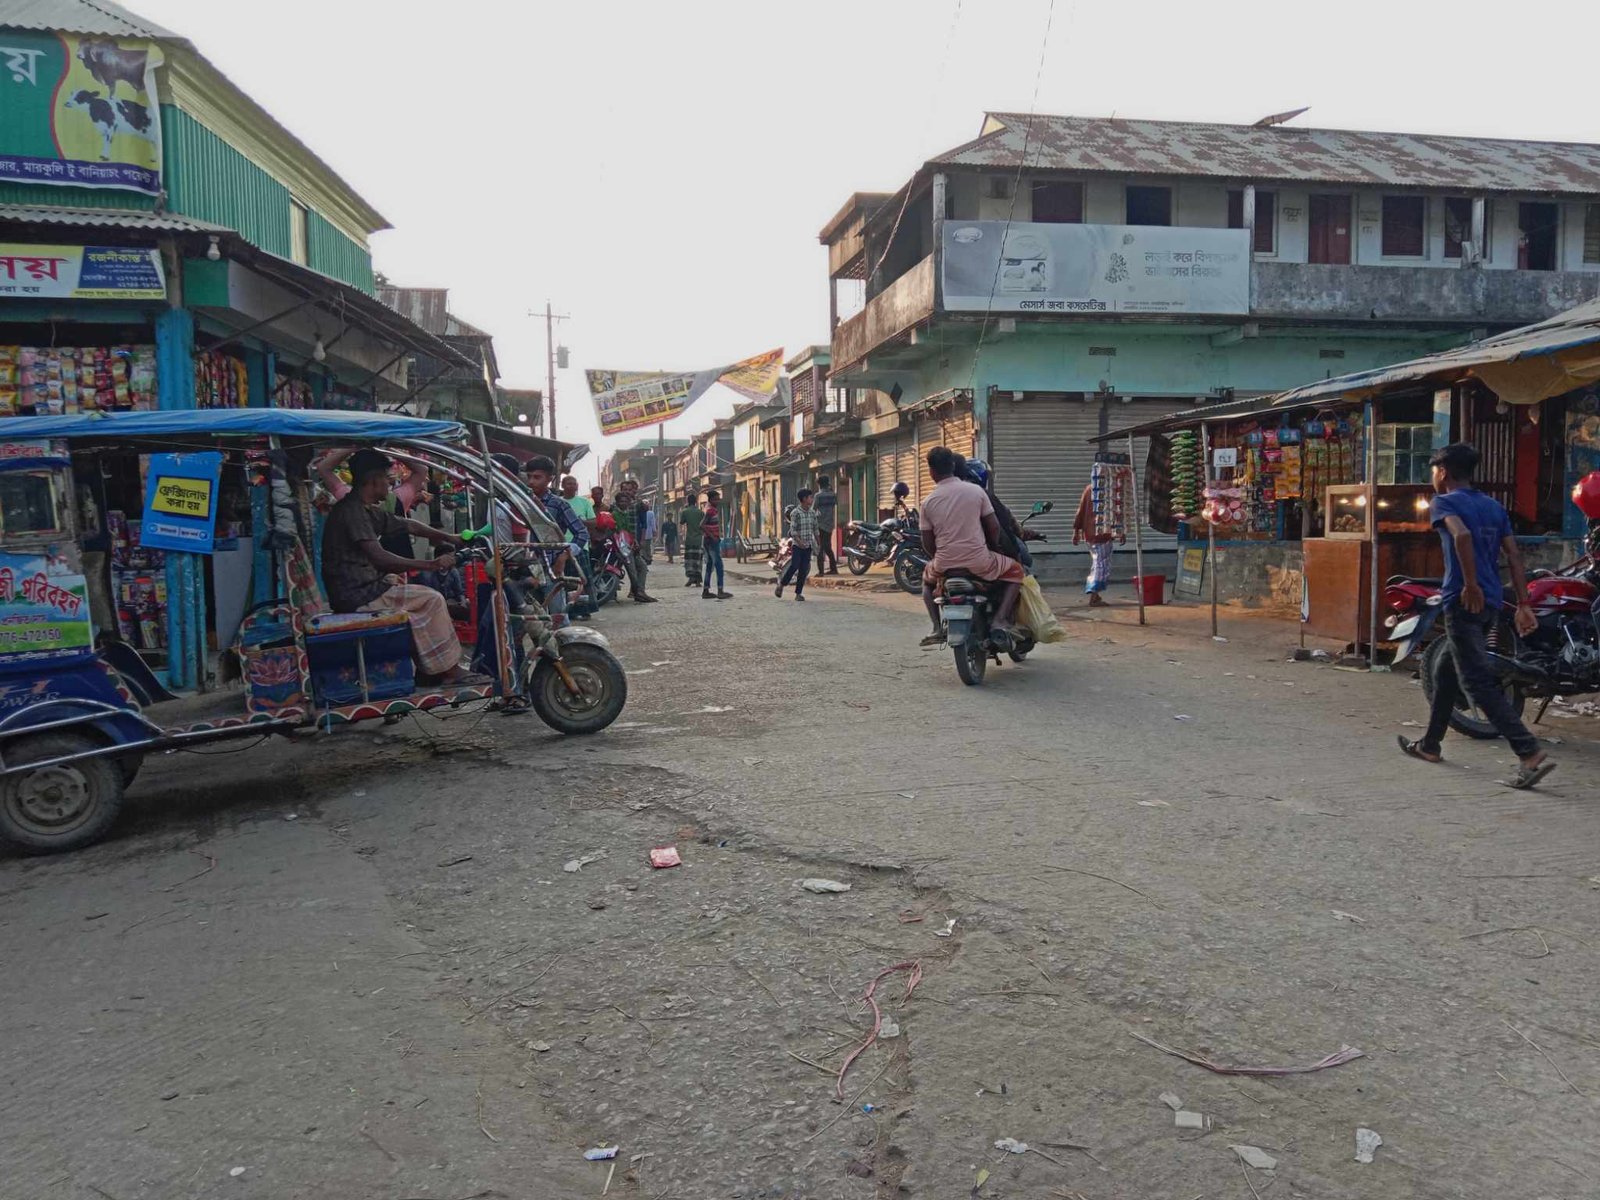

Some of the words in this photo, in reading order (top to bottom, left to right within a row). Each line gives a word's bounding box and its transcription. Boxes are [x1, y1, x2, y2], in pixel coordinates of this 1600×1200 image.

[1173, 252, 1193, 263] করে
[1019, 299, 1045, 310] মেসার্স
[1047, 301, 1064, 310] জবা
[1066, 299, 1106, 311] কসমেটিক্স
[160, 485, 208, 501] ফ্লেক্সিলোড
[166, 498, 185, 509] করা
[187, 501, 200, 511] হয়
[22, 572, 82, 616] পরিবহন
